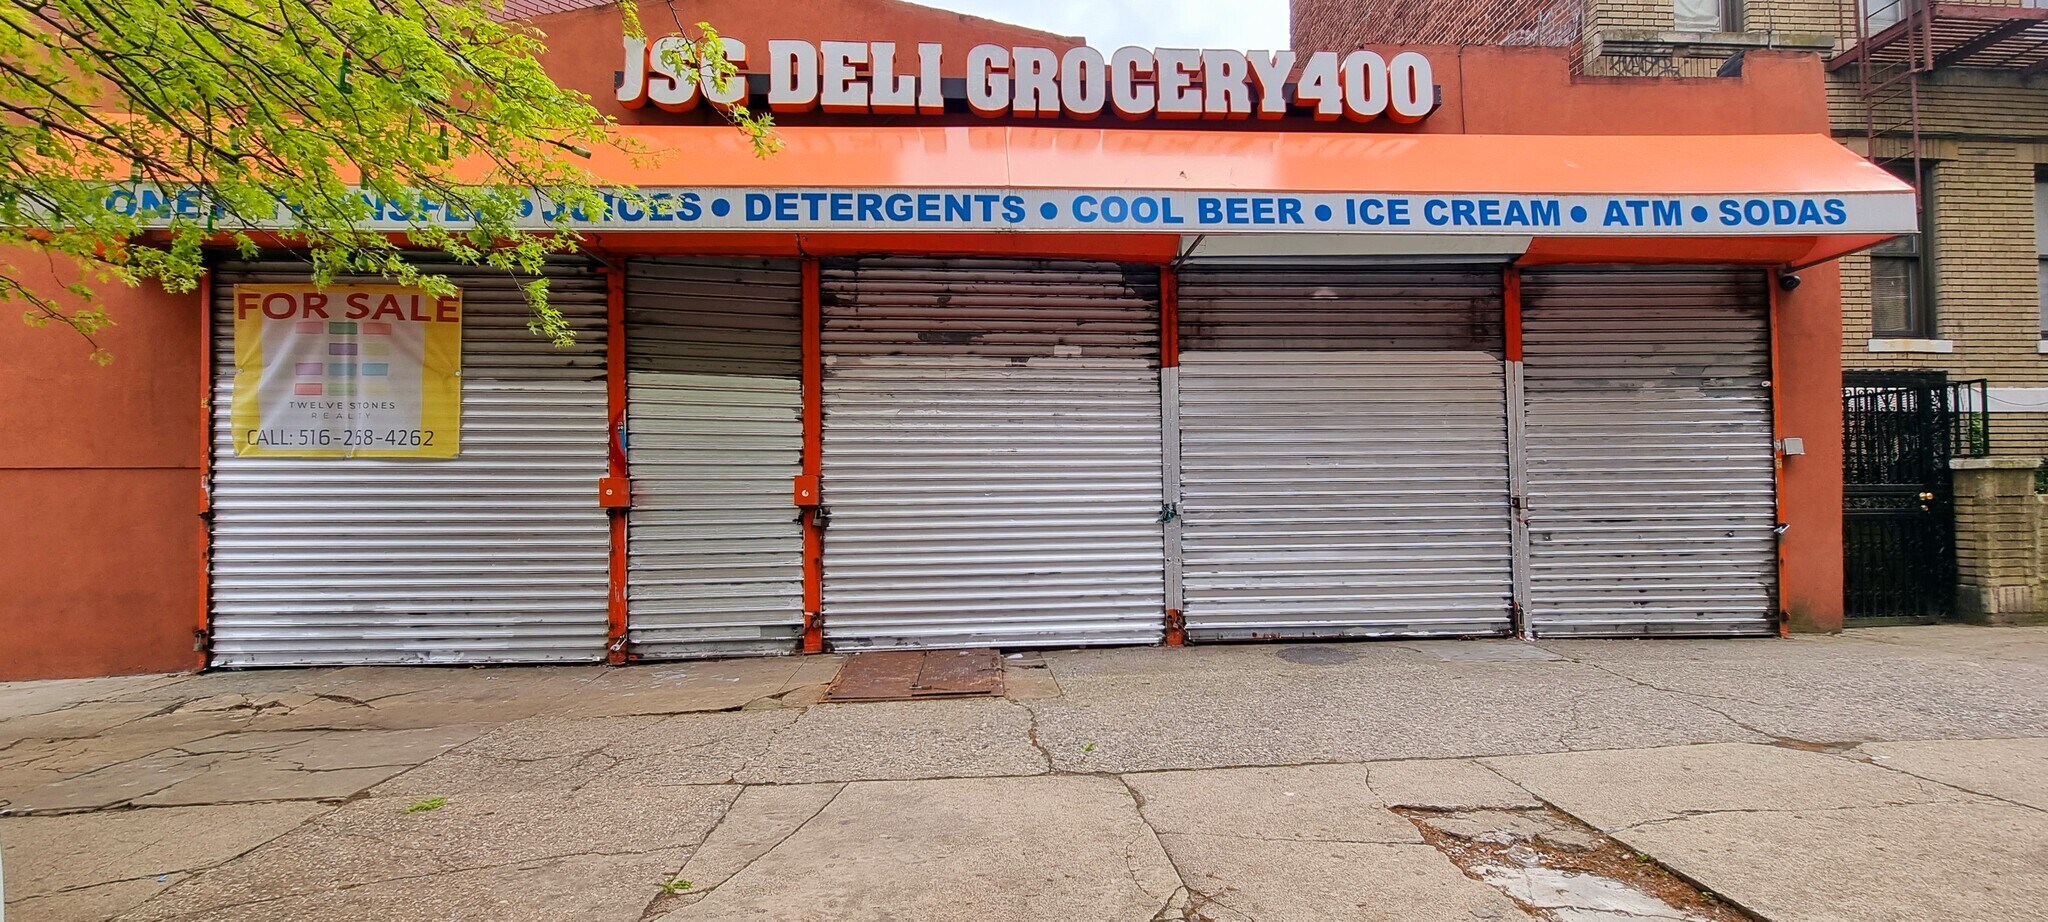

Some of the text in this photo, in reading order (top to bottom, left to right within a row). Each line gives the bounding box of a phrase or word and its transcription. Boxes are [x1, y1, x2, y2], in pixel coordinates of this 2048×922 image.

[768, 39, 945, 107] DELI
[745, 193, 1026, 223] DETERGENTS
[1073, 195, 1184, 224] COOL
[1199, 198, 1304, 225] BEER
[1346, 199, 1411, 225] ICE
[1423, 199, 1561, 227] CREAM
[1603, 200, 1683, 227] ATM
[1719, 199, 1848, 227] SODAS
[237, 292, 460, 323] FOR SALE
[289, 401, 396, 410] TWELVE STONES
[246, 428, 435, 447] CALL: 516-268-4262
